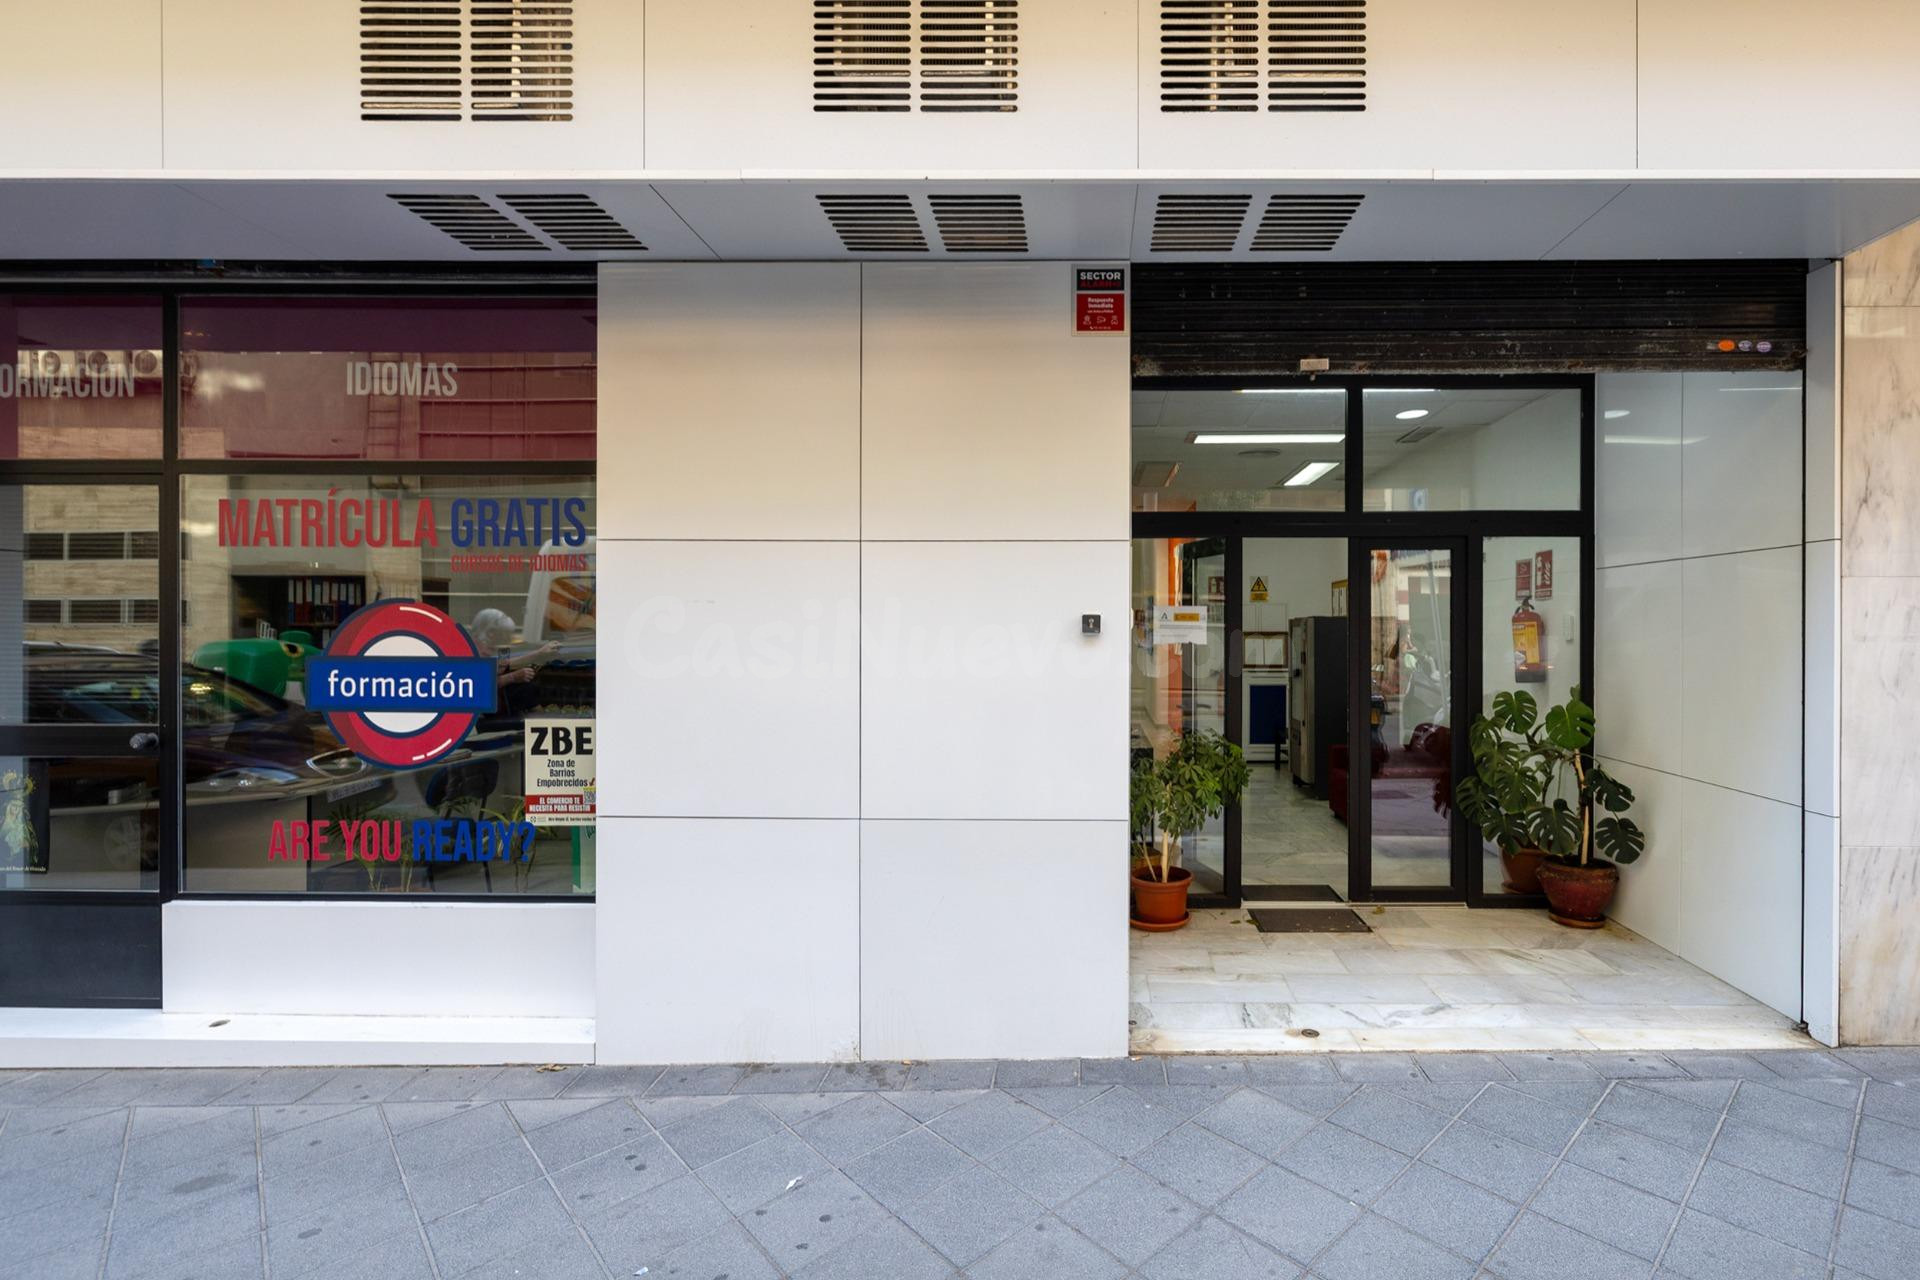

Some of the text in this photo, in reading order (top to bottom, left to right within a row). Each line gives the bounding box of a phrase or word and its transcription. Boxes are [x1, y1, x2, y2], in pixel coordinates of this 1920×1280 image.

[1080, 271, 1121, 280] SECTOR
[346, 361, 458, 397] IDIOMAS
[218, 488, 587, 548] MATRÍCULA GRATIS
[450, 553, 588, 573] CURSOS DE IDIOMAS
[328, 669, 475, 698] formación
[530, 726, 594, 756] ZBE
[547, 759, 576, 768] Zona de
[549, 769, 575, 777] Barrios
[536, 778, 588, 788] Empobrecidos
[539, 796, 545, 804] EL
[268, 818, 536, 863] ARE YOU READY?
